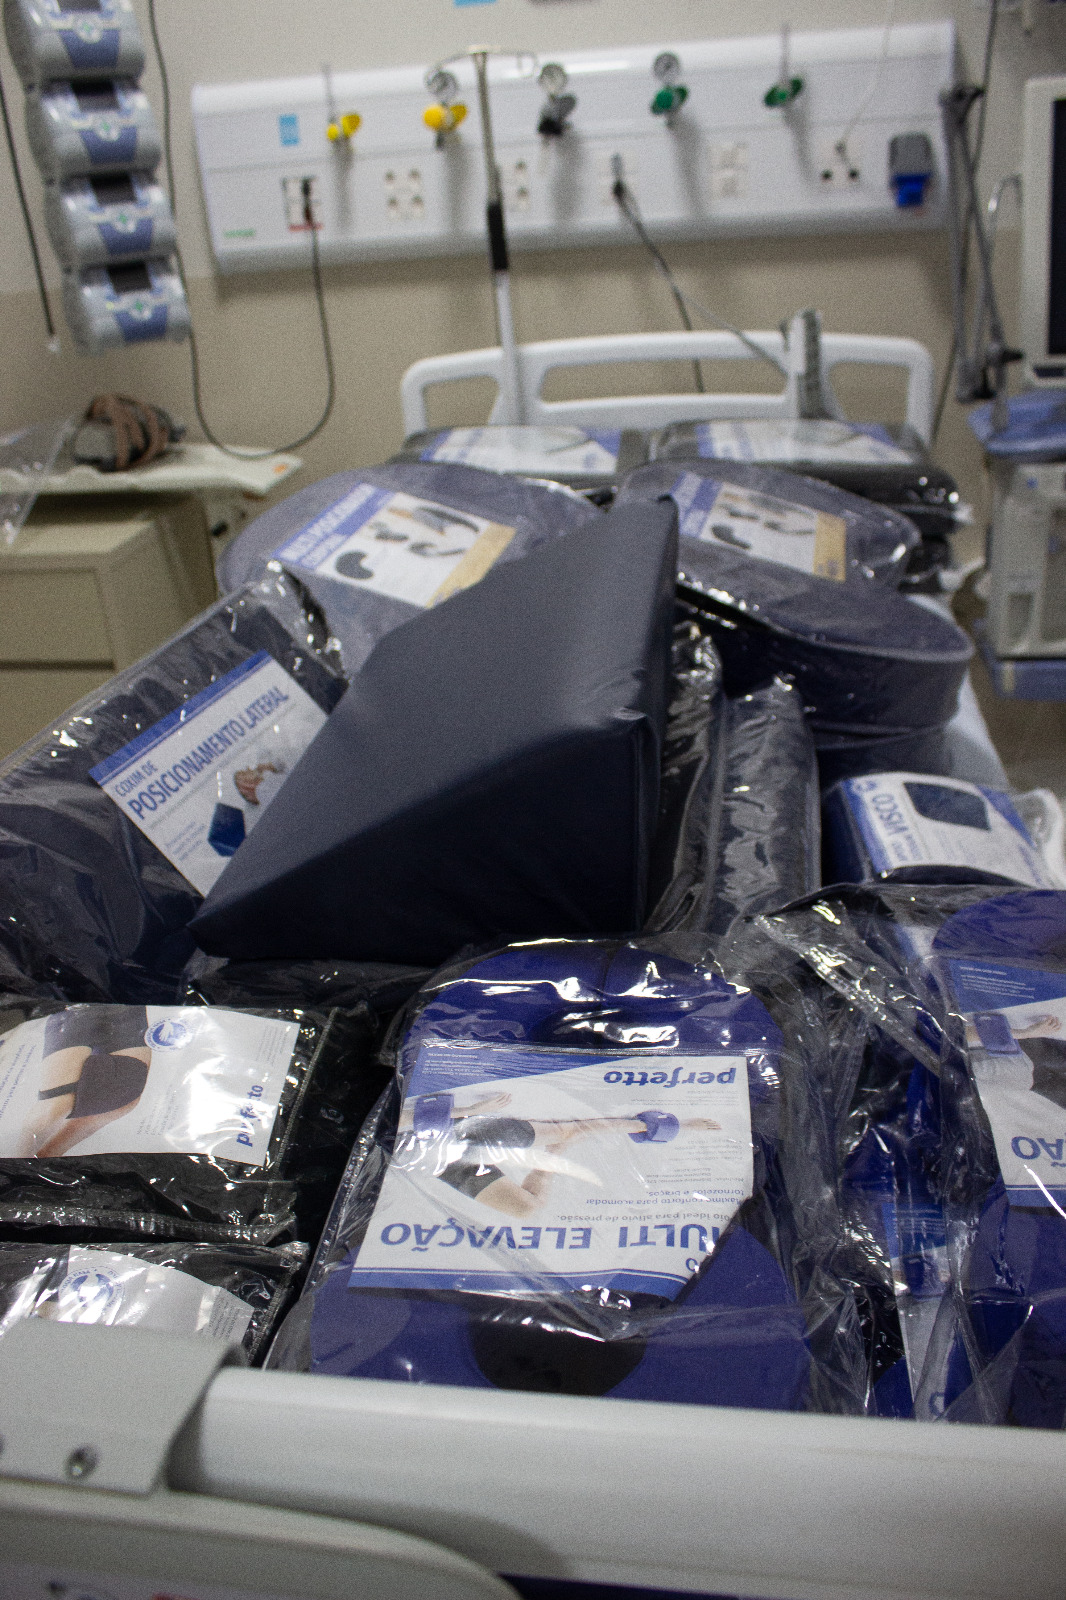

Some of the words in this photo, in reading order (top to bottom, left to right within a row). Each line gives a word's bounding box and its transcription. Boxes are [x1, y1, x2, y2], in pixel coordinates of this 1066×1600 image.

[126, 719, 246, 820] POSICIONAMENTO
[239, 685, 290, 730] LATERAL
[114, 770, 146, 797] COXIM
[143, 760, 159, 776] DE
[603, 1066, 737, 1089] perfetto
[380, 1217, 593, 1252] ELEVAÇÃO
[618, 1223, 720, 1252] ULTI
